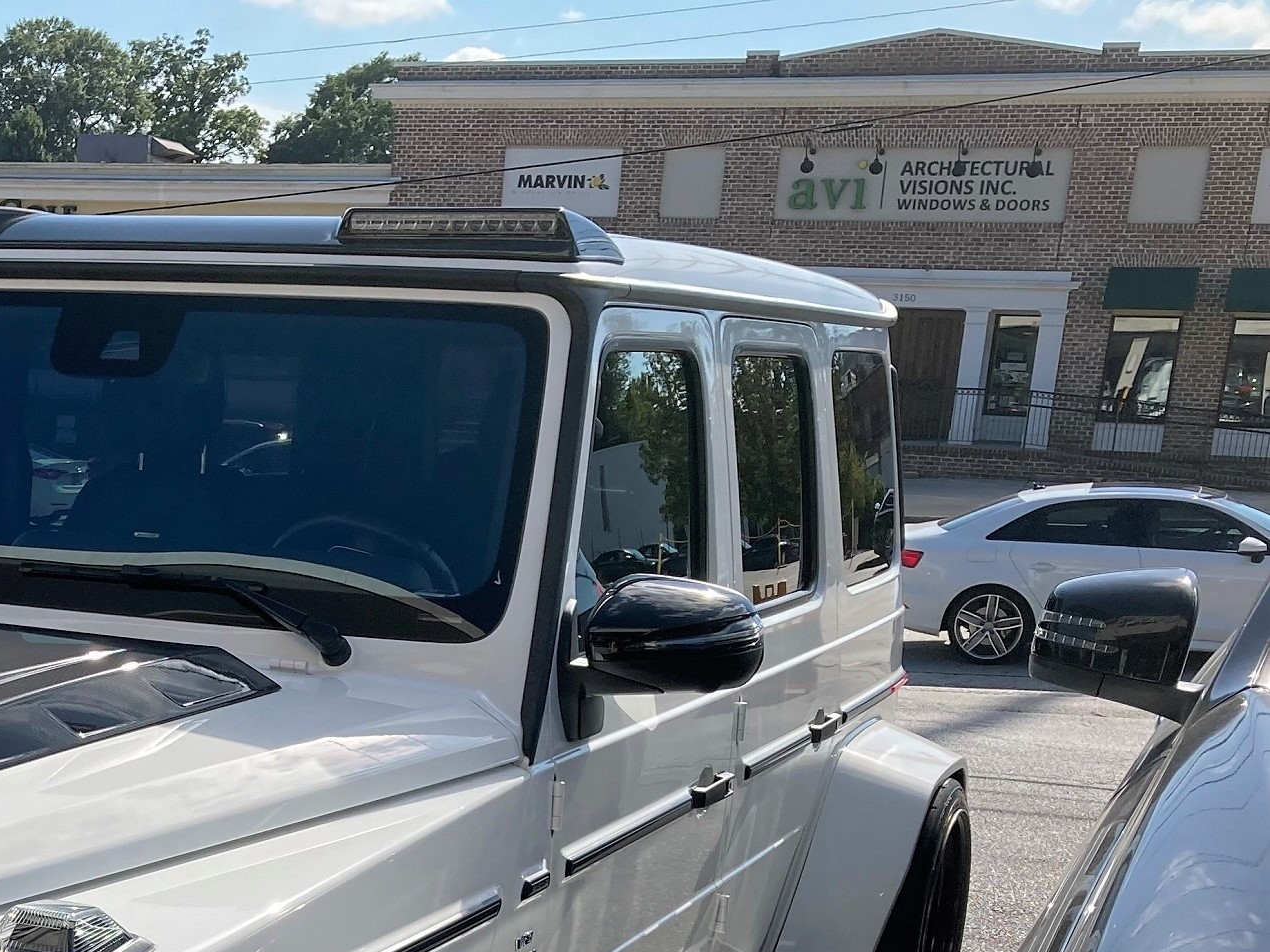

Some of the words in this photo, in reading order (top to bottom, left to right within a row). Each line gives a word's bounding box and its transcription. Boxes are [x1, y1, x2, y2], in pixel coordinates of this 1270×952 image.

[901, 160, 1054, 177] ARCHECTURL
[517, 174, 585, 188] MARVIN
[788, 160, 868, 210] avi
[900, 180, 974, 195] VISIONS
[980, 180, 1017, 196] INC.
[897, 198, 976, 211] WINDOWS
[980, 199, 991, 211] &
[995, 199, 1050, 211] DOORS
[893, 293, 917, 303] 3150
